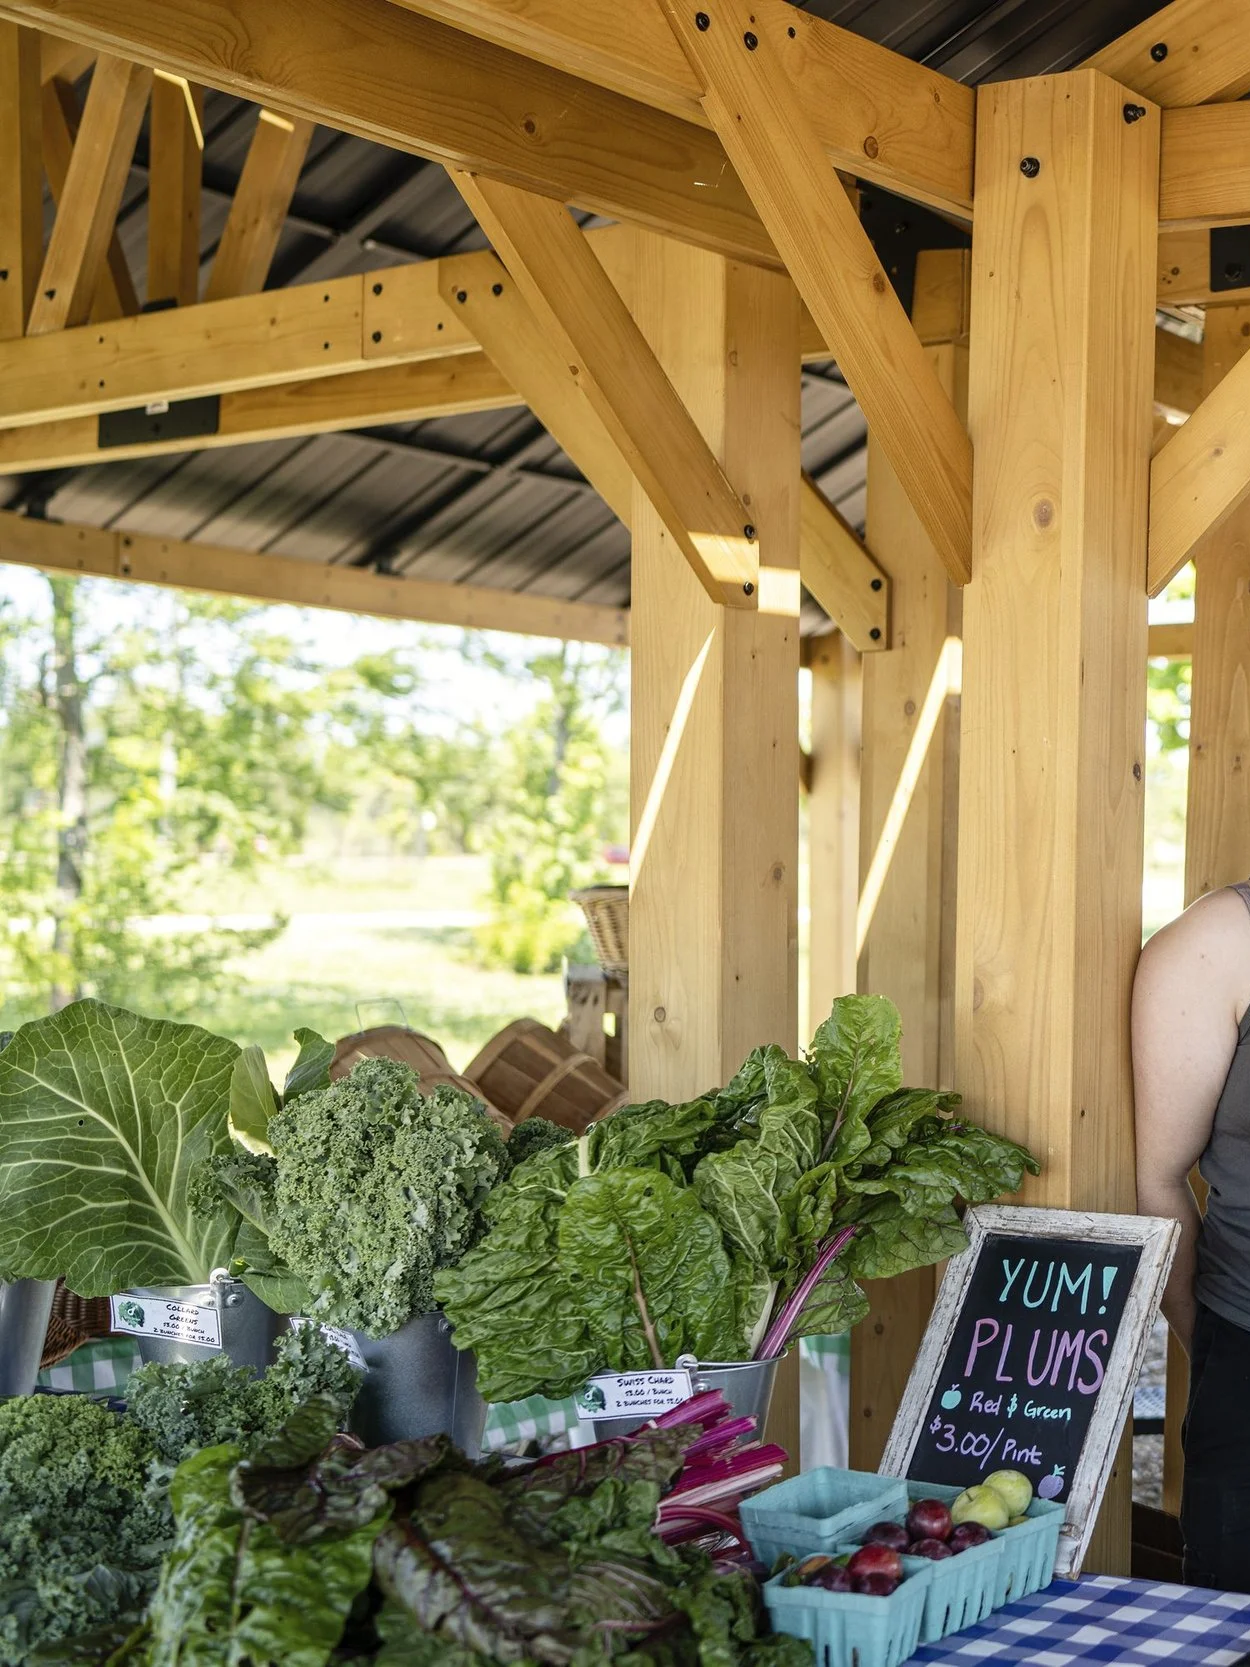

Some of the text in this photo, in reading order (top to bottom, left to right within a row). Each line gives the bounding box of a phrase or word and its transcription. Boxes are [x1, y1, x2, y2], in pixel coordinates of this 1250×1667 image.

[999, 1258, 1119, 1315] YUM!
[166, 1303, 200, 1316] COLLARD
[169, 1314, 199, 1325] GREENS
[963, 1317, 1109, 1395] PLUMS
[616, 1376, 675, 1388] SWISS CHARD
[969, 1391, 1003, 1417] Red
[1023, 1400, 1073, 1421] Green
